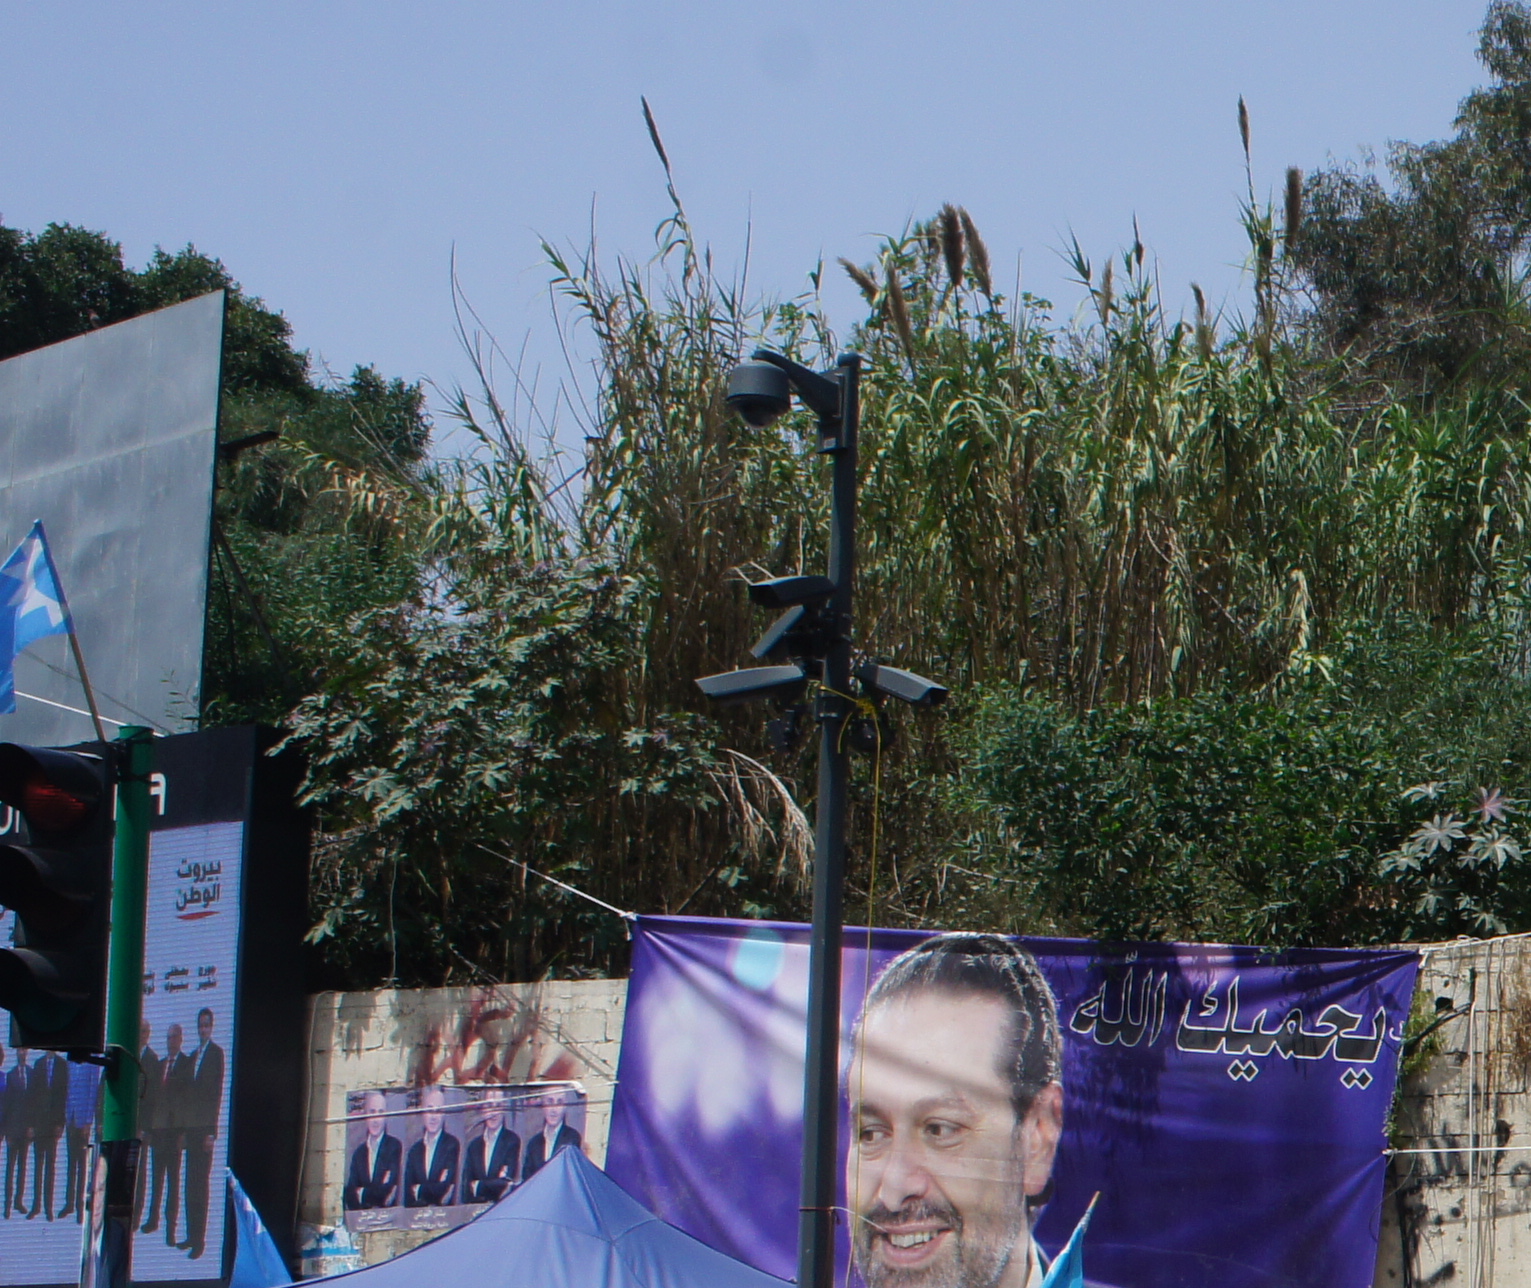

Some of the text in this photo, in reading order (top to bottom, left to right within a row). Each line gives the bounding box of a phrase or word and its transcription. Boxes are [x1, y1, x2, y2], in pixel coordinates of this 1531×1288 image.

[177, 858, 222, 883] بيروت
[175, 883, 221, 911] الوطن
[1070, 951, 1386, 1090] يحميك الله
